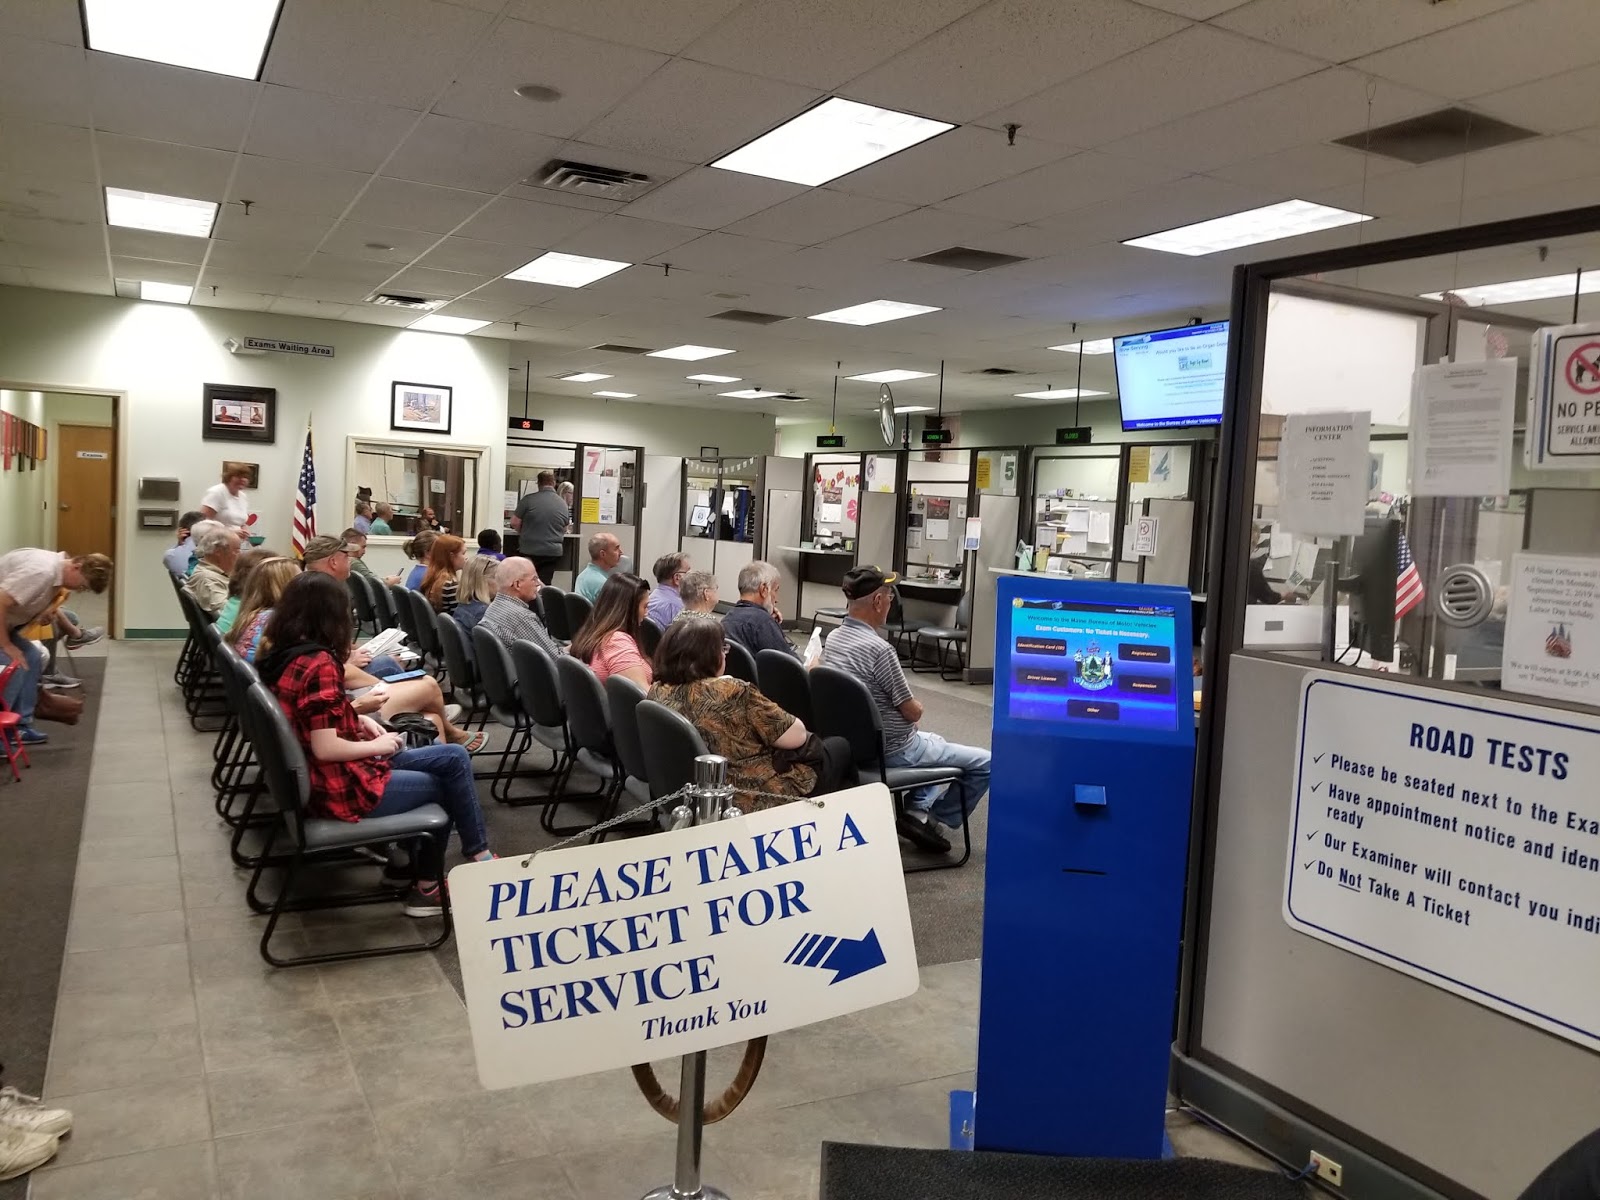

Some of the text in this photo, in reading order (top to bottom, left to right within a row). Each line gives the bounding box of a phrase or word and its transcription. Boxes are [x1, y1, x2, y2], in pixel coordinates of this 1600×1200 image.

[248, 340, 330, 355] Exams Waiting Area
[1557, 402, 1577, 418] NO
[1305, 424, 1353, 433] INFORMATION
[1314, 433, 1342, 441] CENTER
[1557, 425, 1584, 435] SERVICE
[586, 451, 601, 473] 7
[866, 457, 875, 478] 6
[1004, 461, 1015, 481] 5
[1153, 450, 1170, 482] 4
[1531, 577, 1554, 585] closed
[1555, 568, 1582, 576] Offices
[1583, 570, 1598, 578] will
[1526, 585, 1563, 595] September
[1574, 590, 1593, 598] 2019
[1529, 604, 1550, 613] Labor
[1552, 607, 1566, 617] Day
[1582, 600, 1593, 608] the
[1035, 624, 1052, 632] Exam
[1052, 626, 1085, 634] Customers:
[1095, 628, 1112, 636] Ticket
[1409, 722, 1570, 781] ROAD TESTS
[1330, 753, 1600, 836] Please be seated next to the Exa
[1327, 805, 1365, 829] ready
[1328, 783, 1600, 872] Have appointment notice and iden
[485, 812, 869, 922] PLEASE TAKE A
[1317, 860, 1471, 926] Do Not Take A Ticket
[1324, 833, 1600, 934] Our Examiner will contact you indi
[490, 879, 812, 975] TICKET FOR
[499, 954, 720, 1030] SERVICE
[641, 999, 769, 1040] Thank You
